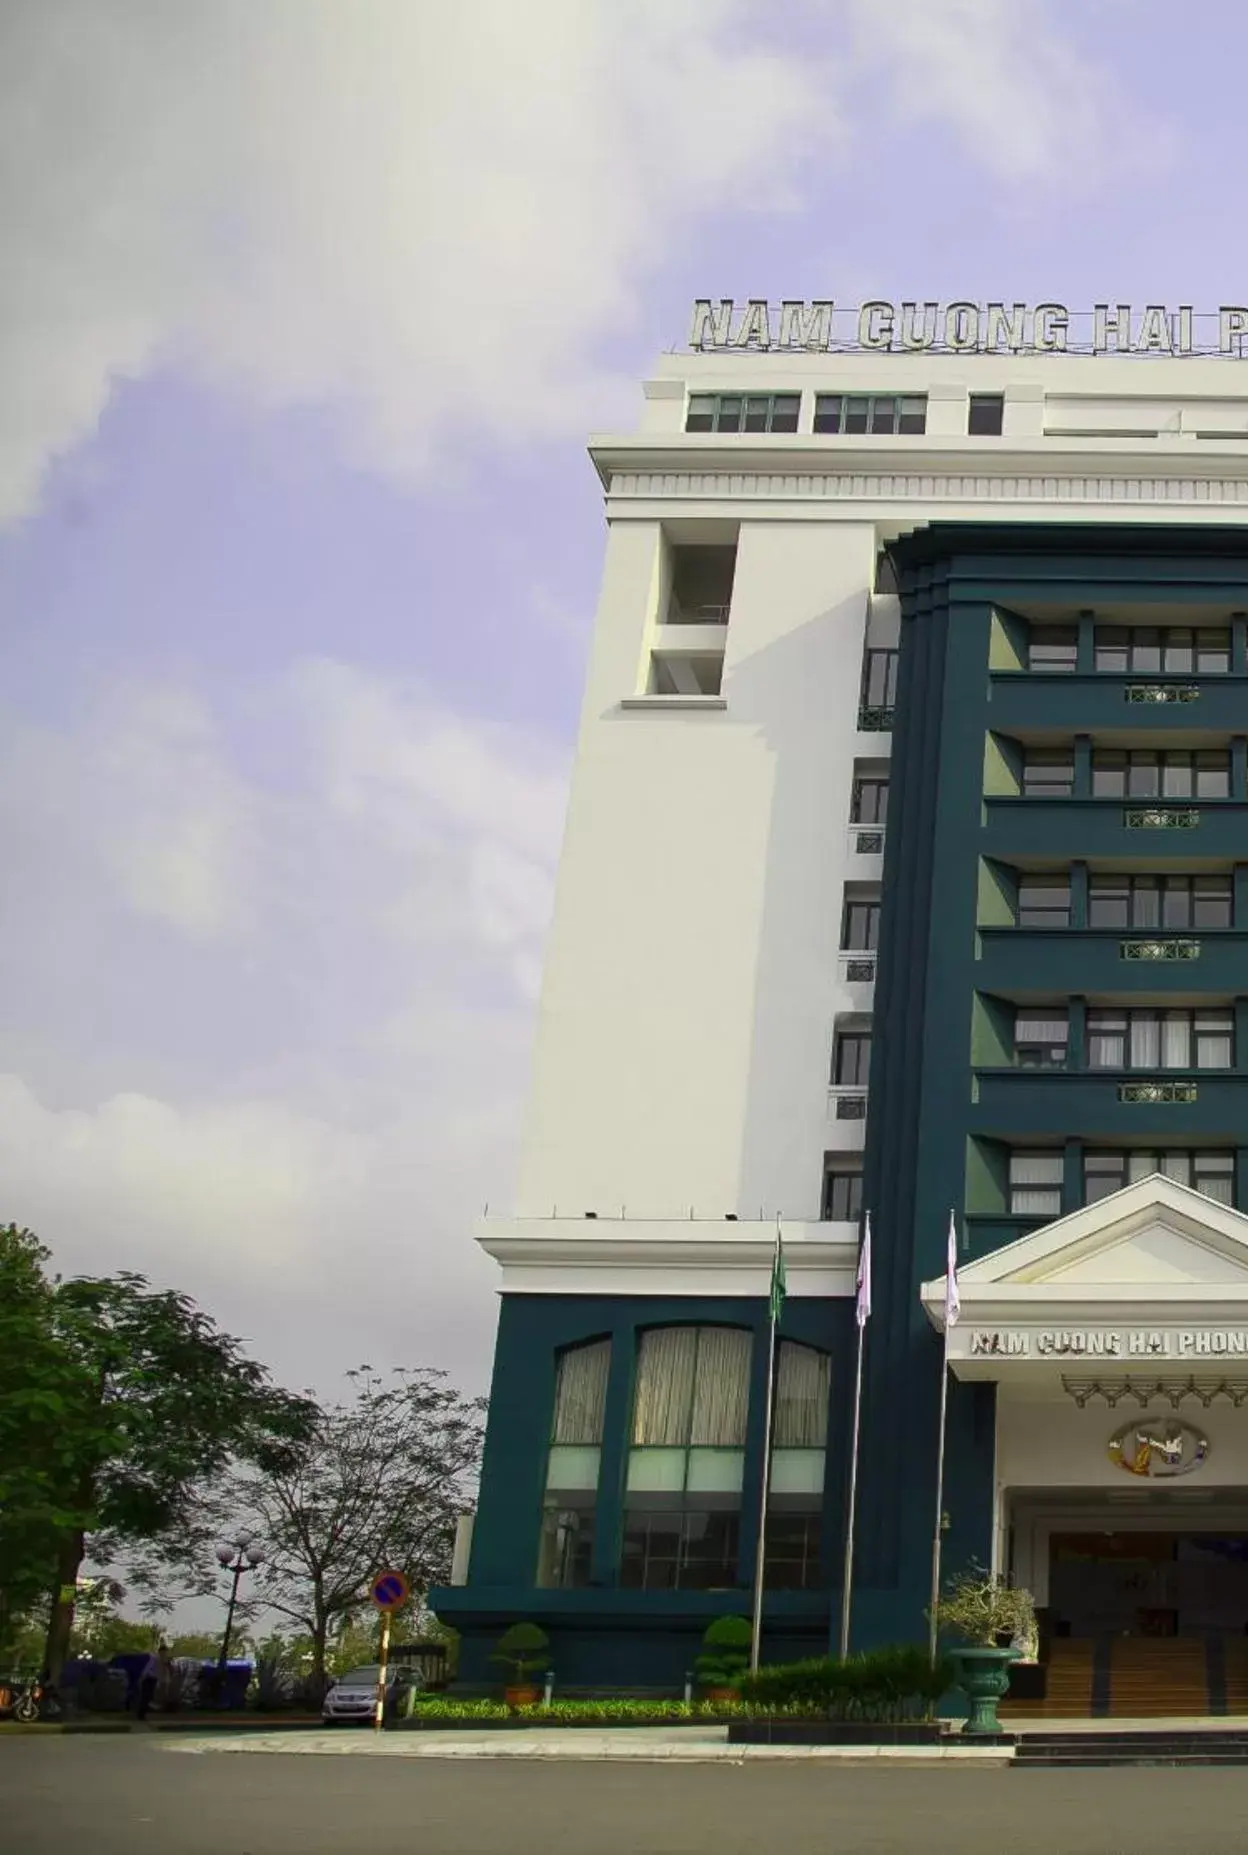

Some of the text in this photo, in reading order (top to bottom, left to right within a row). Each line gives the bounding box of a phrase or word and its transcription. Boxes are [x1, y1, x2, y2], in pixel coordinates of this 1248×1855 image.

[689, 299, 834, 348] NAM
[858, 301, 1069, 351] CUONG
[1093, 303, 1194, 353] HAI
[971, 1331, 1030, 1355] NAM
[1038, 1331, 1121, 1355] CUONG
[1129, 1331, 1170, 1354] HAI
